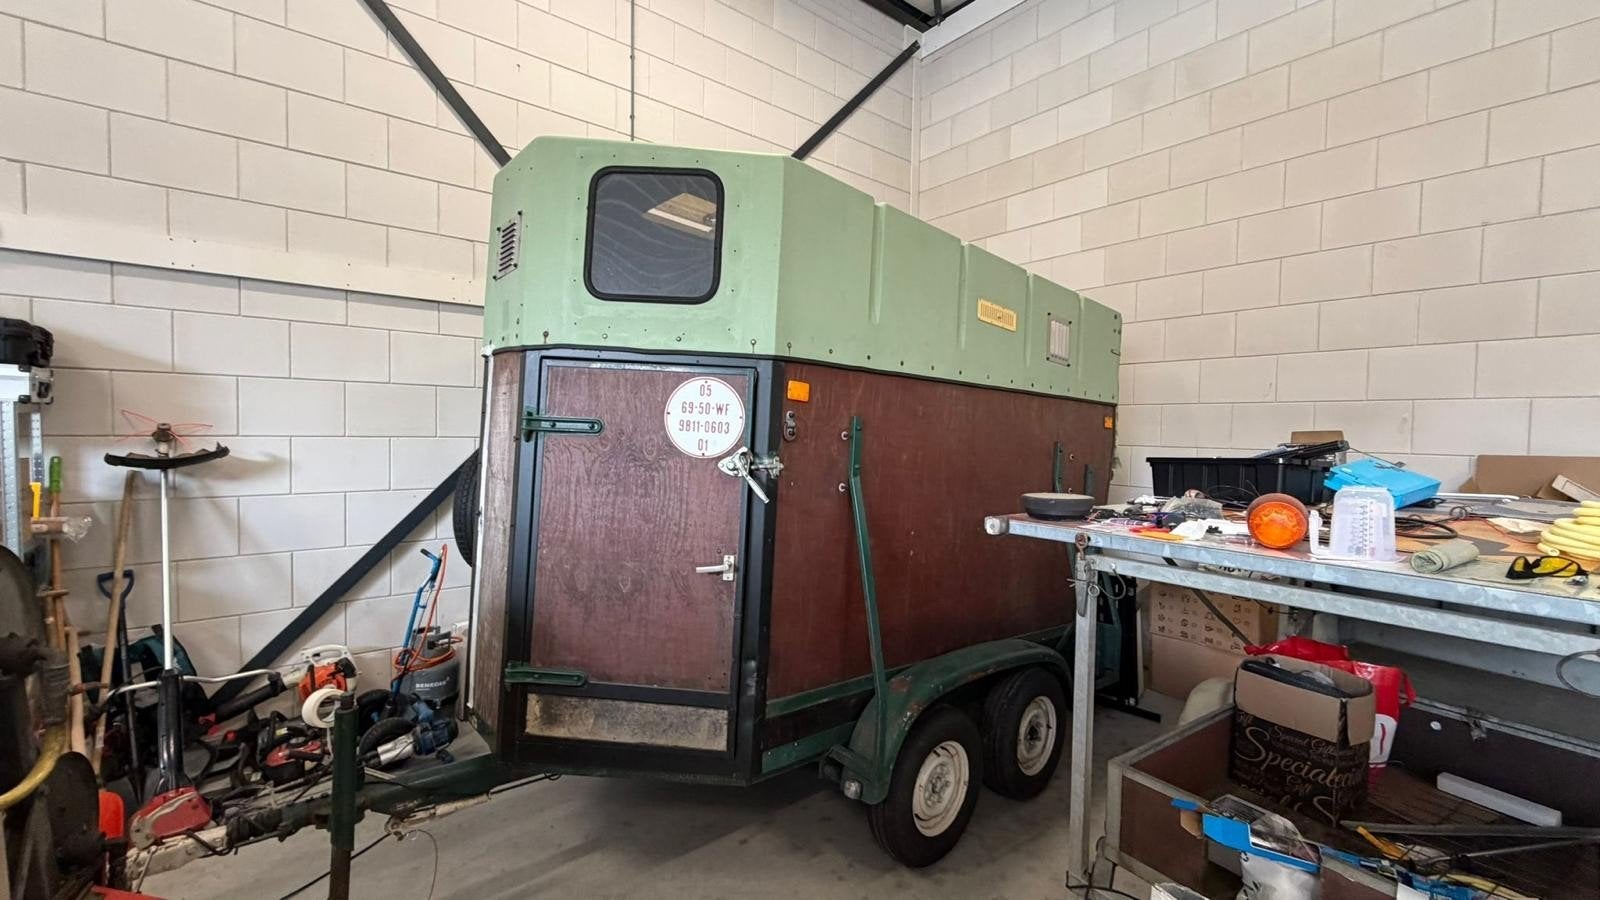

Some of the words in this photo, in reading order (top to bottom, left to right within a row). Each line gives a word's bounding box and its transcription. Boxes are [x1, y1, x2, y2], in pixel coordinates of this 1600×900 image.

[699, 384, 712, 397] 05
[681, 401, 731, 416] 69-50-WF
[678, 419, 730, 434] 9811-0603
[697, 438, 709, 451] 01
